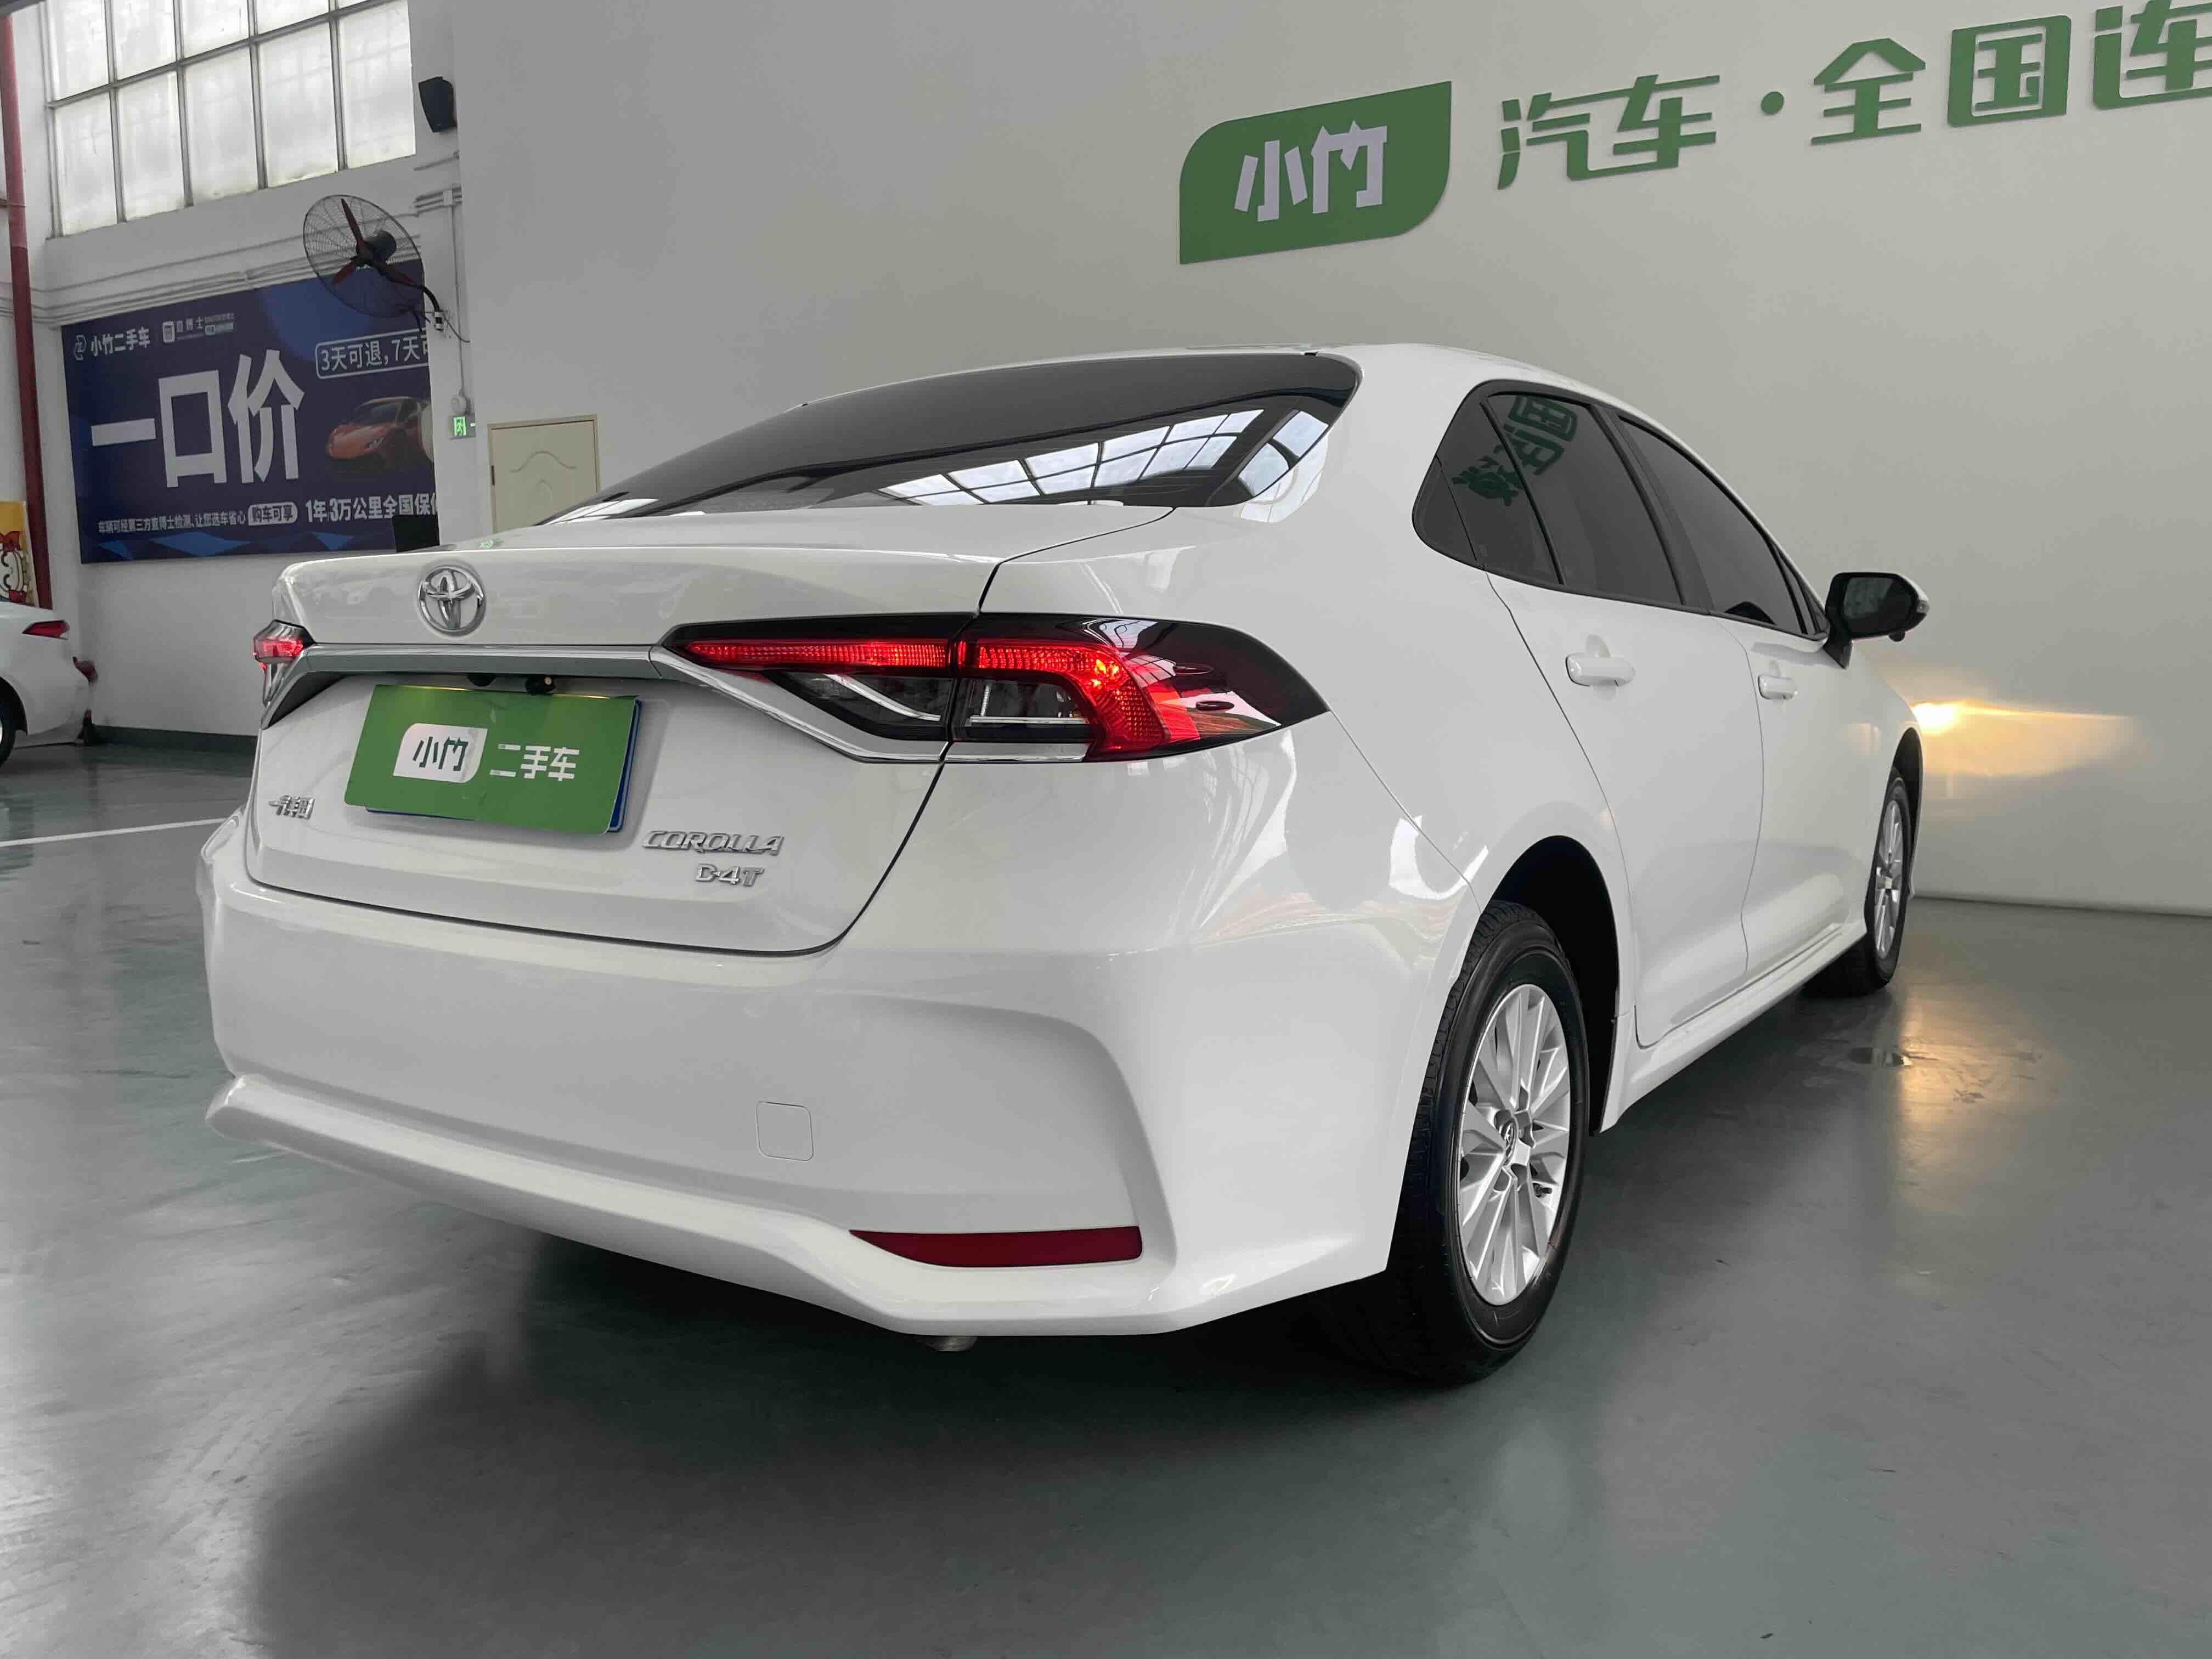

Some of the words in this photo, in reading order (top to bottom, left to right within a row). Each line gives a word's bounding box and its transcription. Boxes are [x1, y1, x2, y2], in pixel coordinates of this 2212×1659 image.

[1234, 119, 1388, 222] 小竹
[90, 325, 151, 357] 小竹二手车
[91, 349, 306, 488] 一口价
[412, 736, 469, 771] 小竹
[489, 743, 580, 782] 二手车
[642, 830, 785, 856] COROLLA
